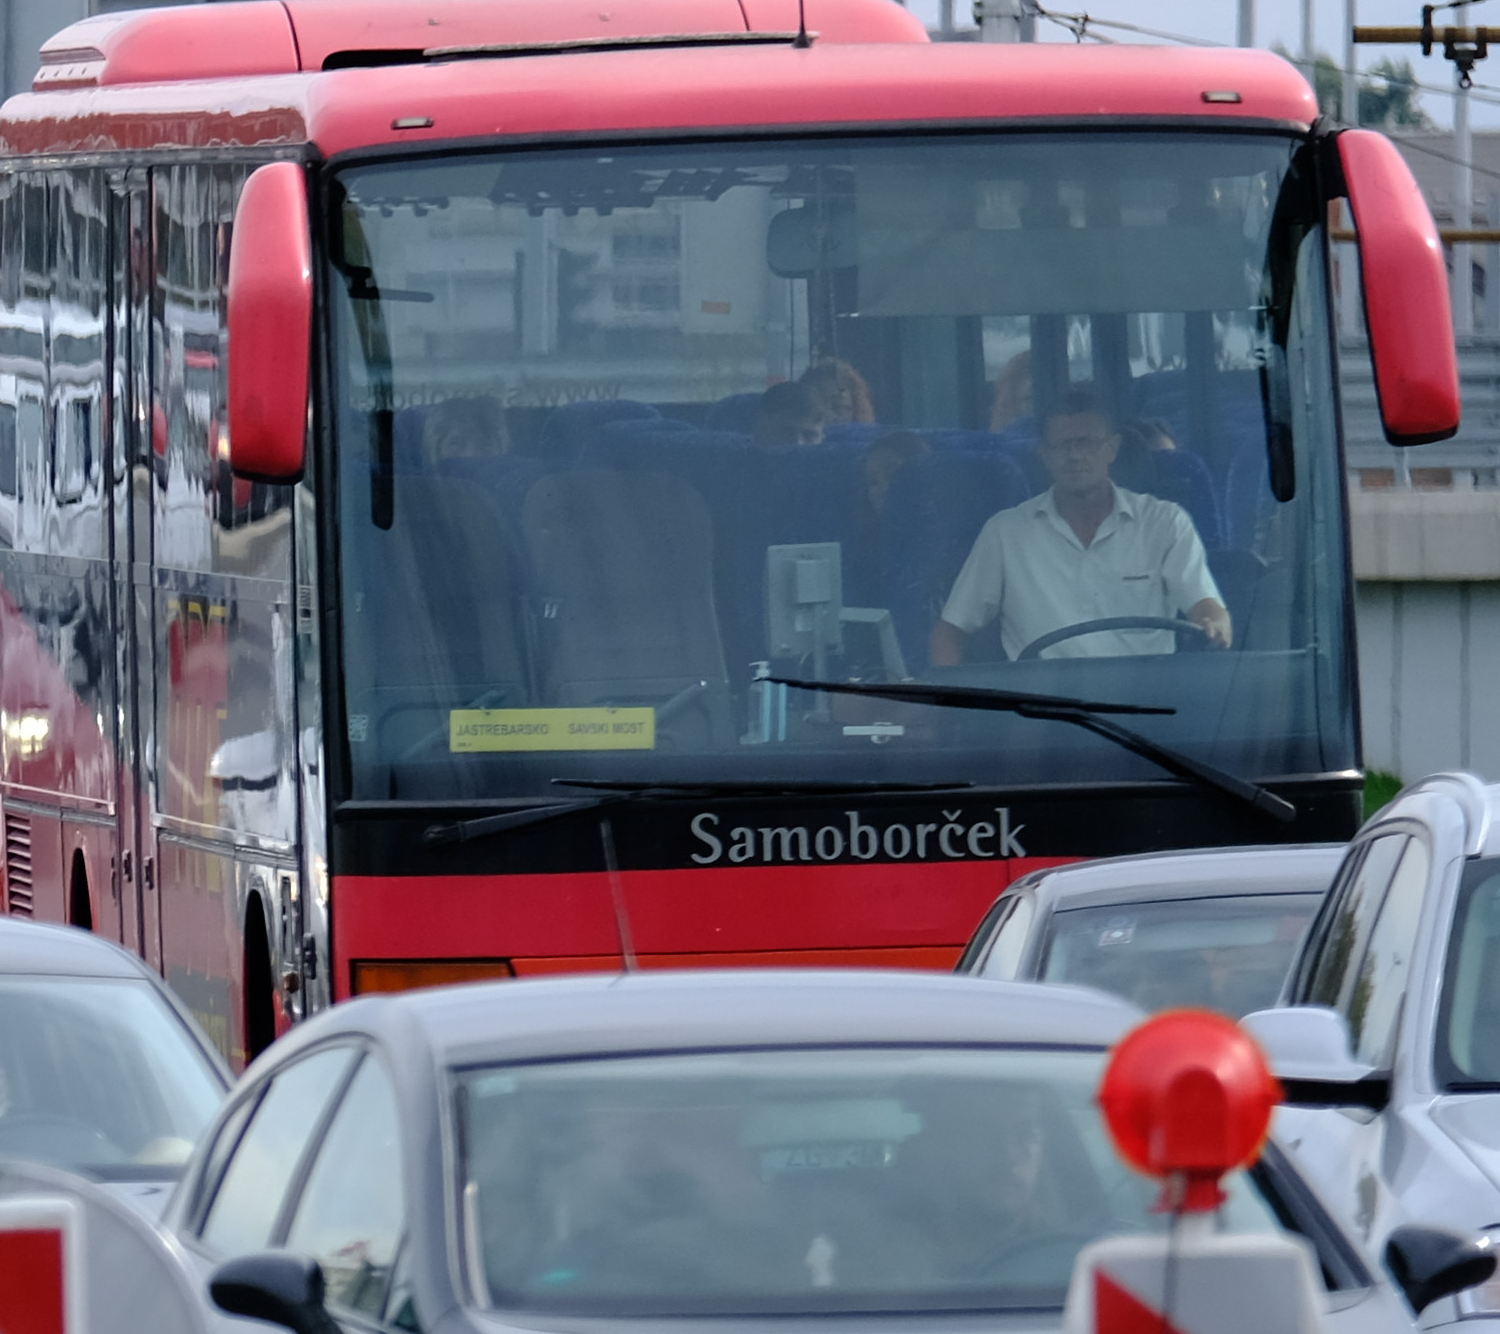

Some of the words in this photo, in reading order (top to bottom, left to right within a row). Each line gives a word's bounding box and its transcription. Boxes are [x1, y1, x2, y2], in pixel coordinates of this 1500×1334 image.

[457, 723, 549, 737] JASTREBARSKO
[612, 722, 645, 734] MOST
[690, 807, 1027, 865] Samoborček
